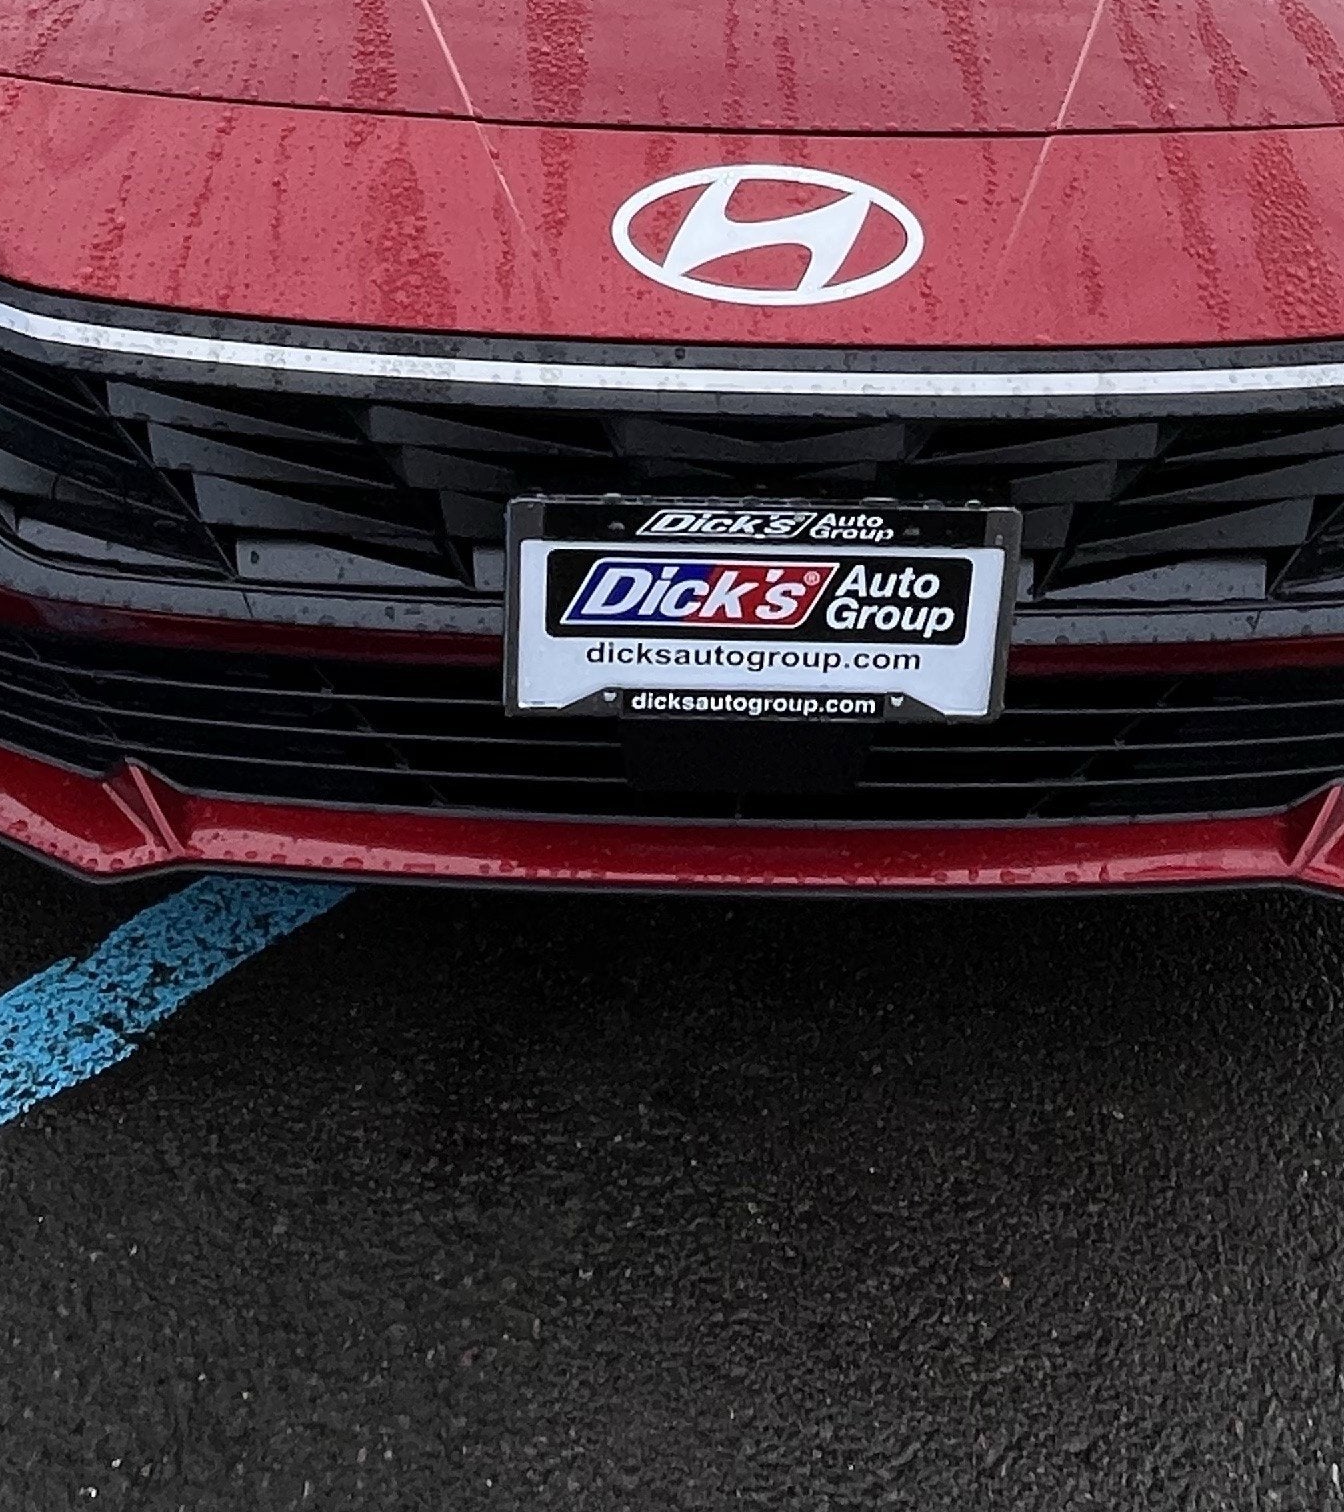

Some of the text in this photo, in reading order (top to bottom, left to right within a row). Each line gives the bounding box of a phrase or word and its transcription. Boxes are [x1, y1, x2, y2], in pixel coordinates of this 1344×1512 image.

[650, 513, 884, 534] Dick's Auto
[809, 525, 895, 542] Group
[581, 564, 940, 621] Dick's Auto
[825, 598, 955, 638] Group
[586, 642, 921, 672] dicksautogroup.com
[630, 693, 877, 715] dicksautogroup.com
